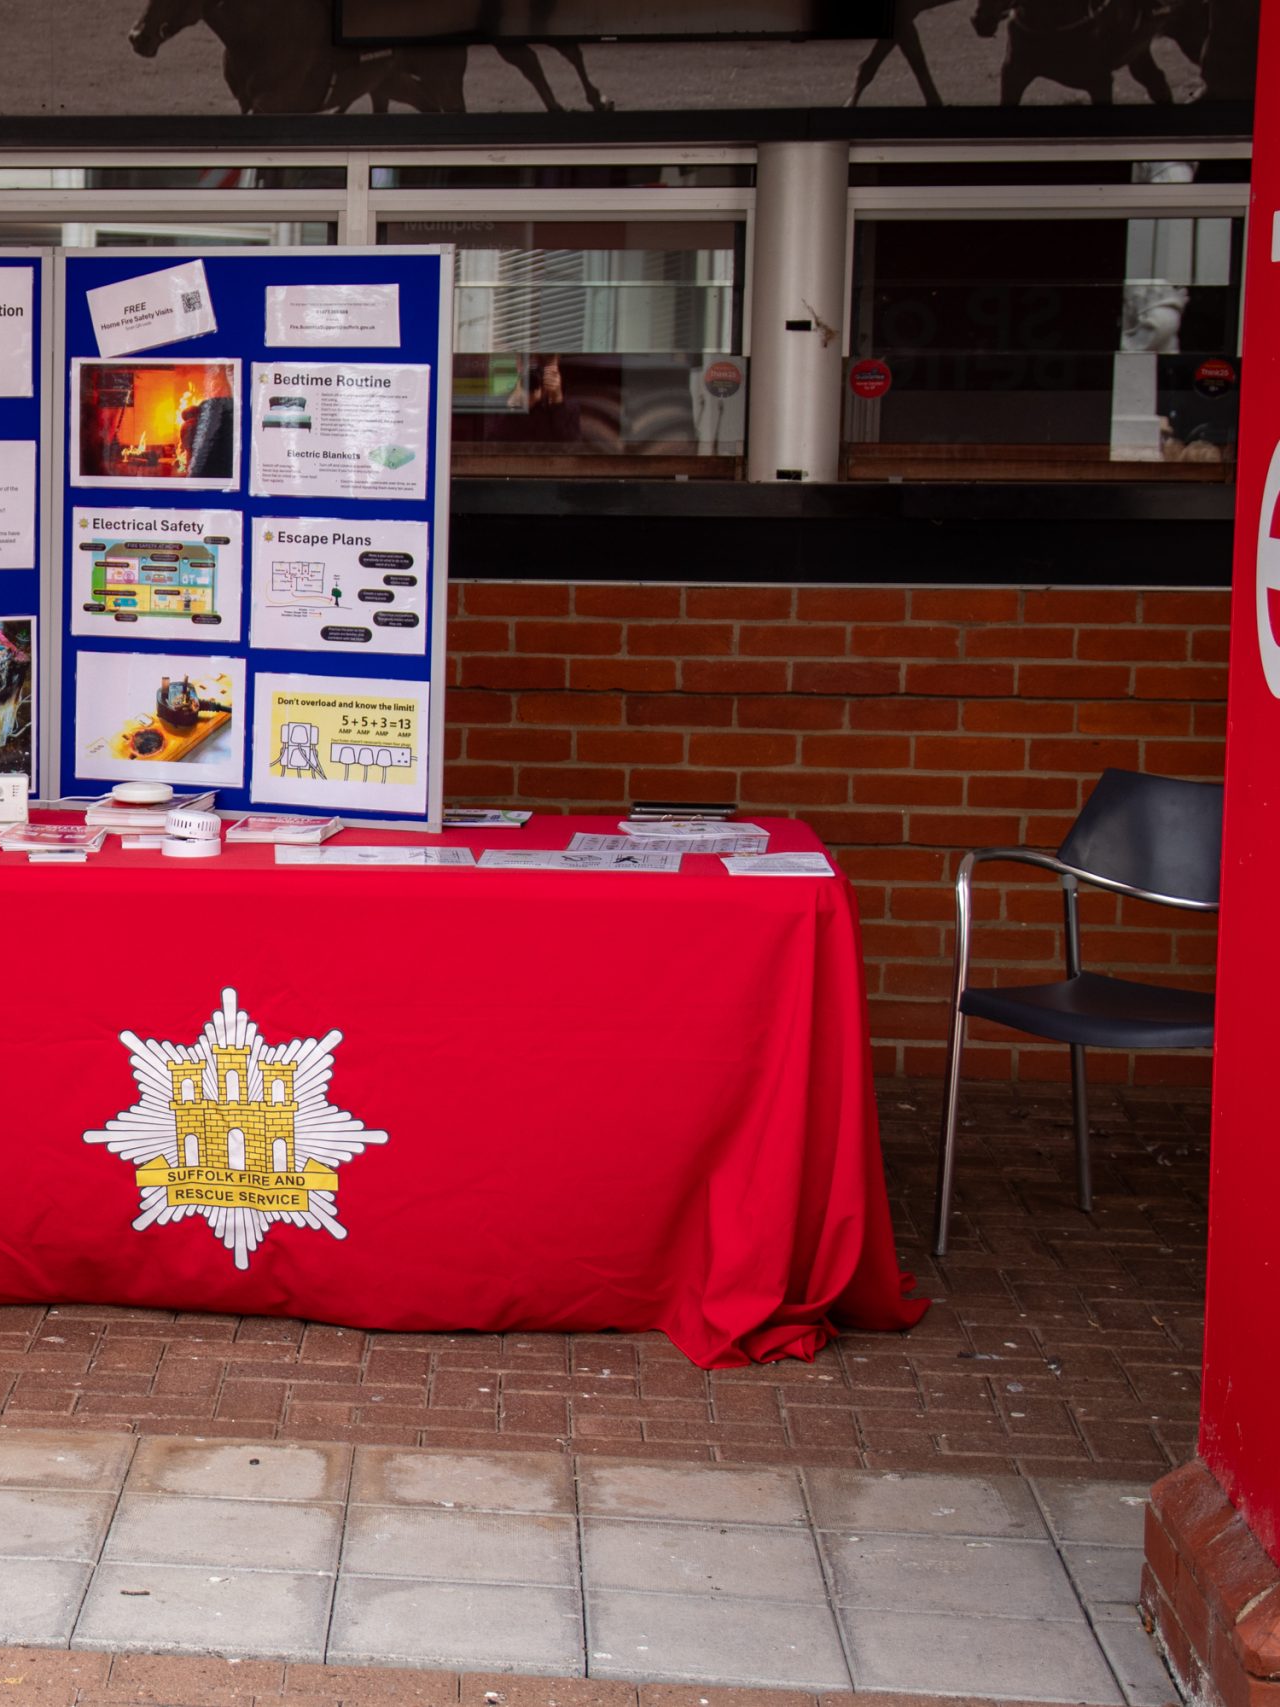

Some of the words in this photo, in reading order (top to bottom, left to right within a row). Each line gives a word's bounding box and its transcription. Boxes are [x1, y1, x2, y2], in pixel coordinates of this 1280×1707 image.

[124, 301, 147, 315] FREE
[101, 321, 120, 331] Home
[121, 317, 133, 326] Fire
[134, 313, 155, 324] Safety
[156, 307, 174, 317] Visits
[1201, 368, 1229, 377] Think25
[274, 373, 332, 386] Bedtime
[336, 375, 391, 388] Routine
[287, 450, 320, 459] Electric
[322, 450, 361, 460] Blankets
[93, 518, 157, 531] Electrical
[160, 520, 204, 535] Safety
[278, 531, 328, 546] Escape
[333, 533, 372, 546] Plans
[278, 697, 299, 706] Don't
[301, 698, 336, 708] overload
[338, 699, 353, 709] and
[355, 700, 377, 710] know
[379, 702, 392, 711] the
[394, 703, 415, 712] limit!
[342, 715, 349, 726] 5
[362, 716, 368, 727] 5
[381, 717, 387, 728] 3
[168, 1170, 234, 1183] SUFFOLK
[239, 1173, 270, 1187] FIRE
[275, 1175, 305, 1187] AND
[176, 1189, 234, 1202] RESCUE
[239, 1191, 300, 1206] SERVICE
